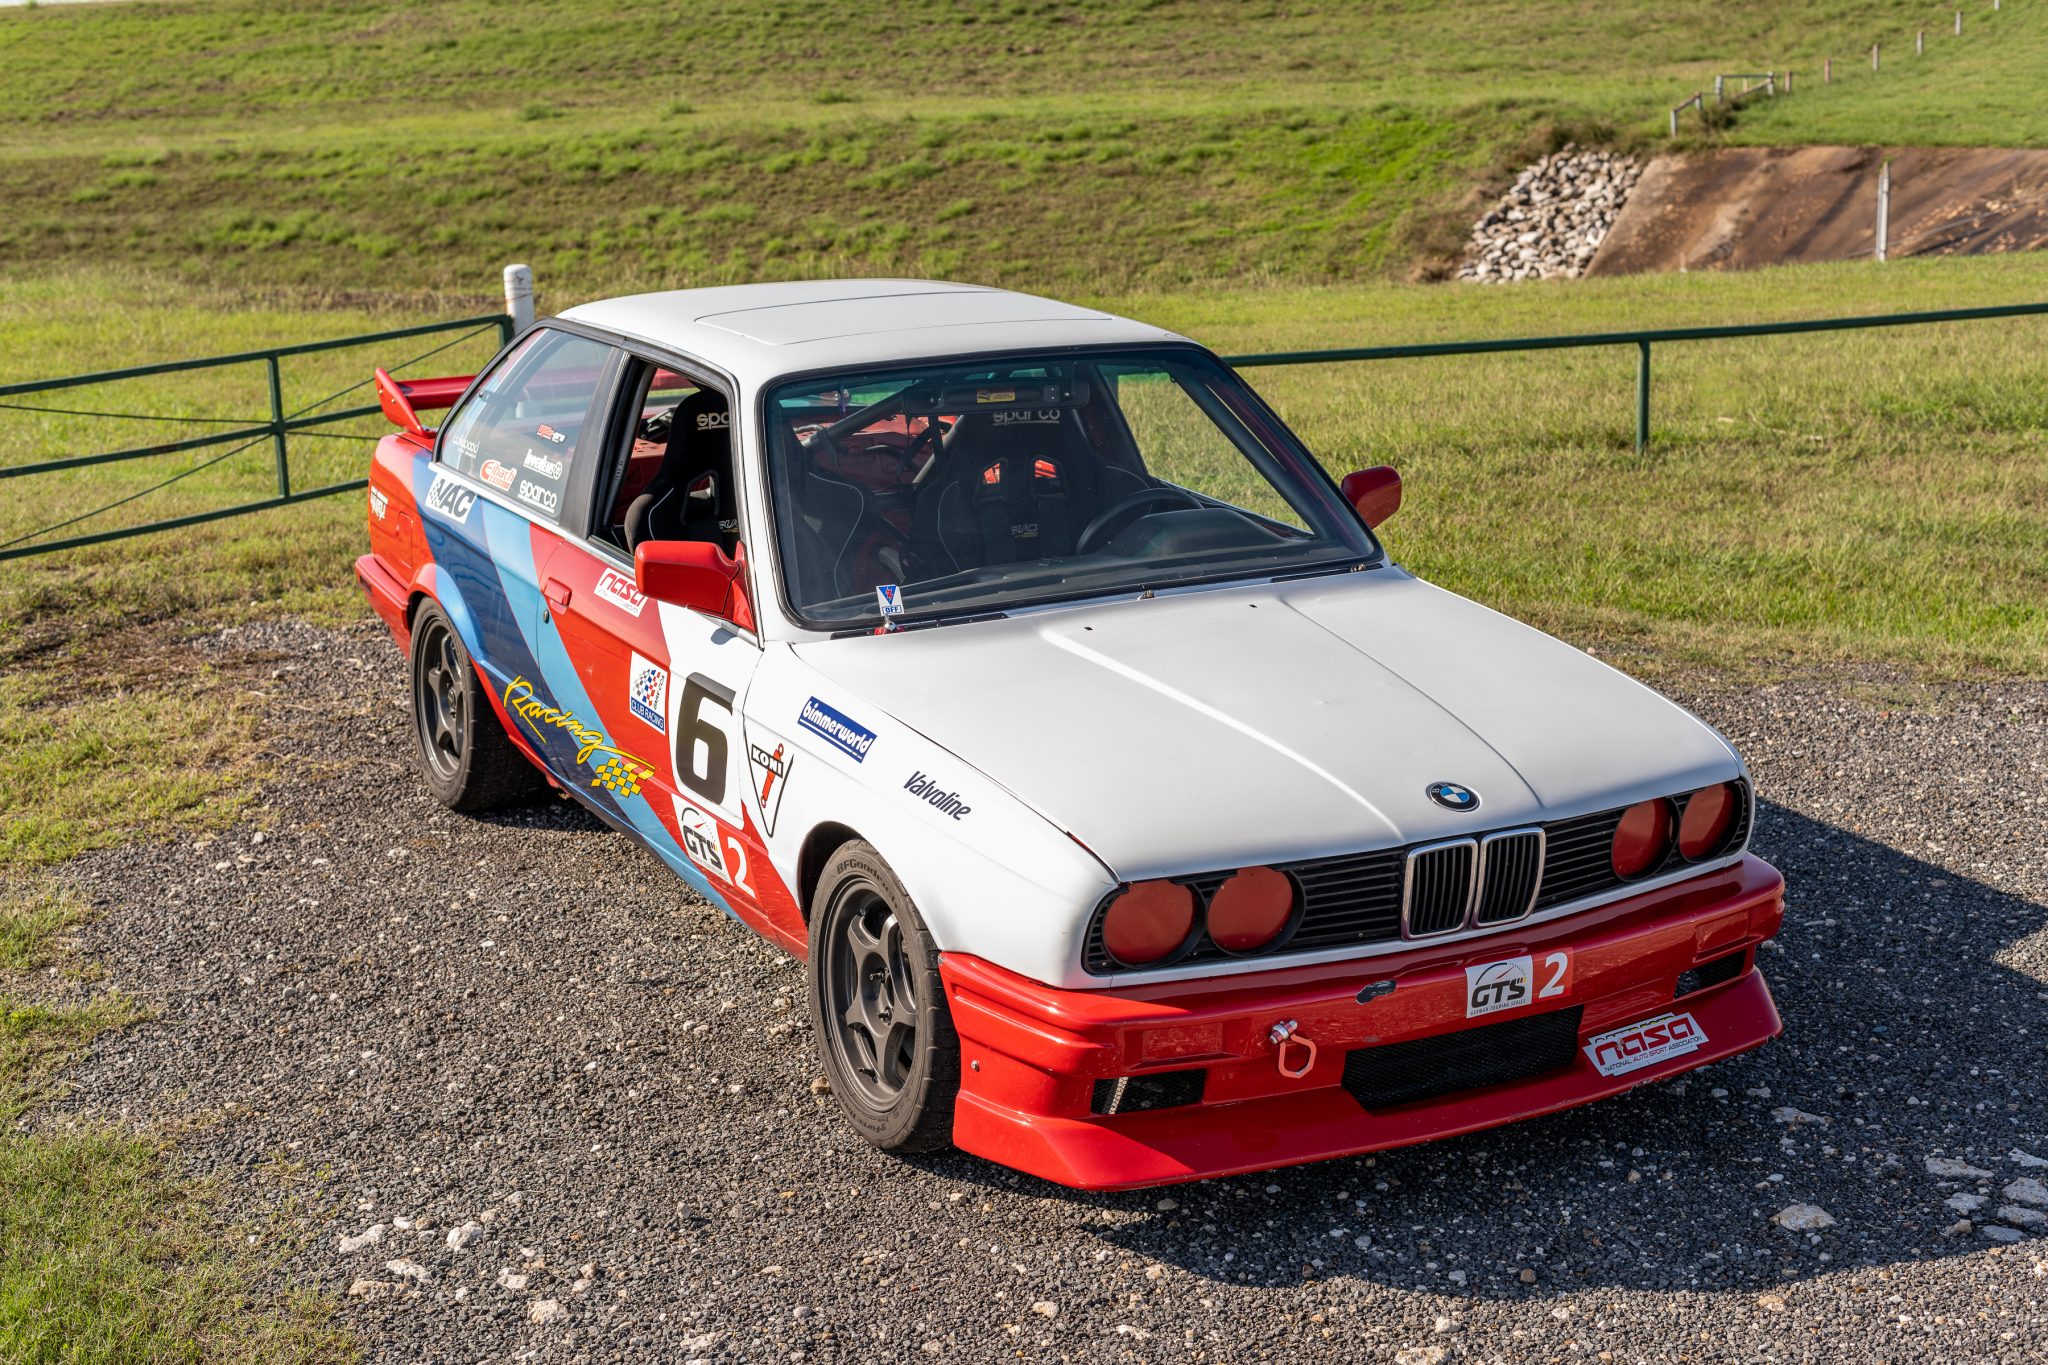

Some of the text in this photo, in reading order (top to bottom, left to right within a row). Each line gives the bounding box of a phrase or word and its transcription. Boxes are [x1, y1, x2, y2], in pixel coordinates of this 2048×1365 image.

[696, 411, 730, 430] spa
[437, 478, 475, 518] VAC
[519, 480, 558, 509] sparco
[599, 572, 645, 607] nasa
[885, 606, 900, 614] OFF
[503, 675, 656, 769] Racing
[631, 699, 664, 729] CLUB RACING
[802, 700, 873, 754] bimmerworld
[675, 671, 737, 806] 6
[752, 747, 783, 775] KONI
[903, 770, 972, 821] Valvoline
[682, 824, 723, 871] GTS
[726, 836, 757, 900] 2
[1471, 952, 1568, 1009] GTS 2
[1470, 999, 1526, 1016] GERMAN TOURING SERIES
[1594, 1017, 1695, 1067] nasa
[1604, 1035, 1703, 1072] NATIONAL AUTO SPORT ASSOCIATION
